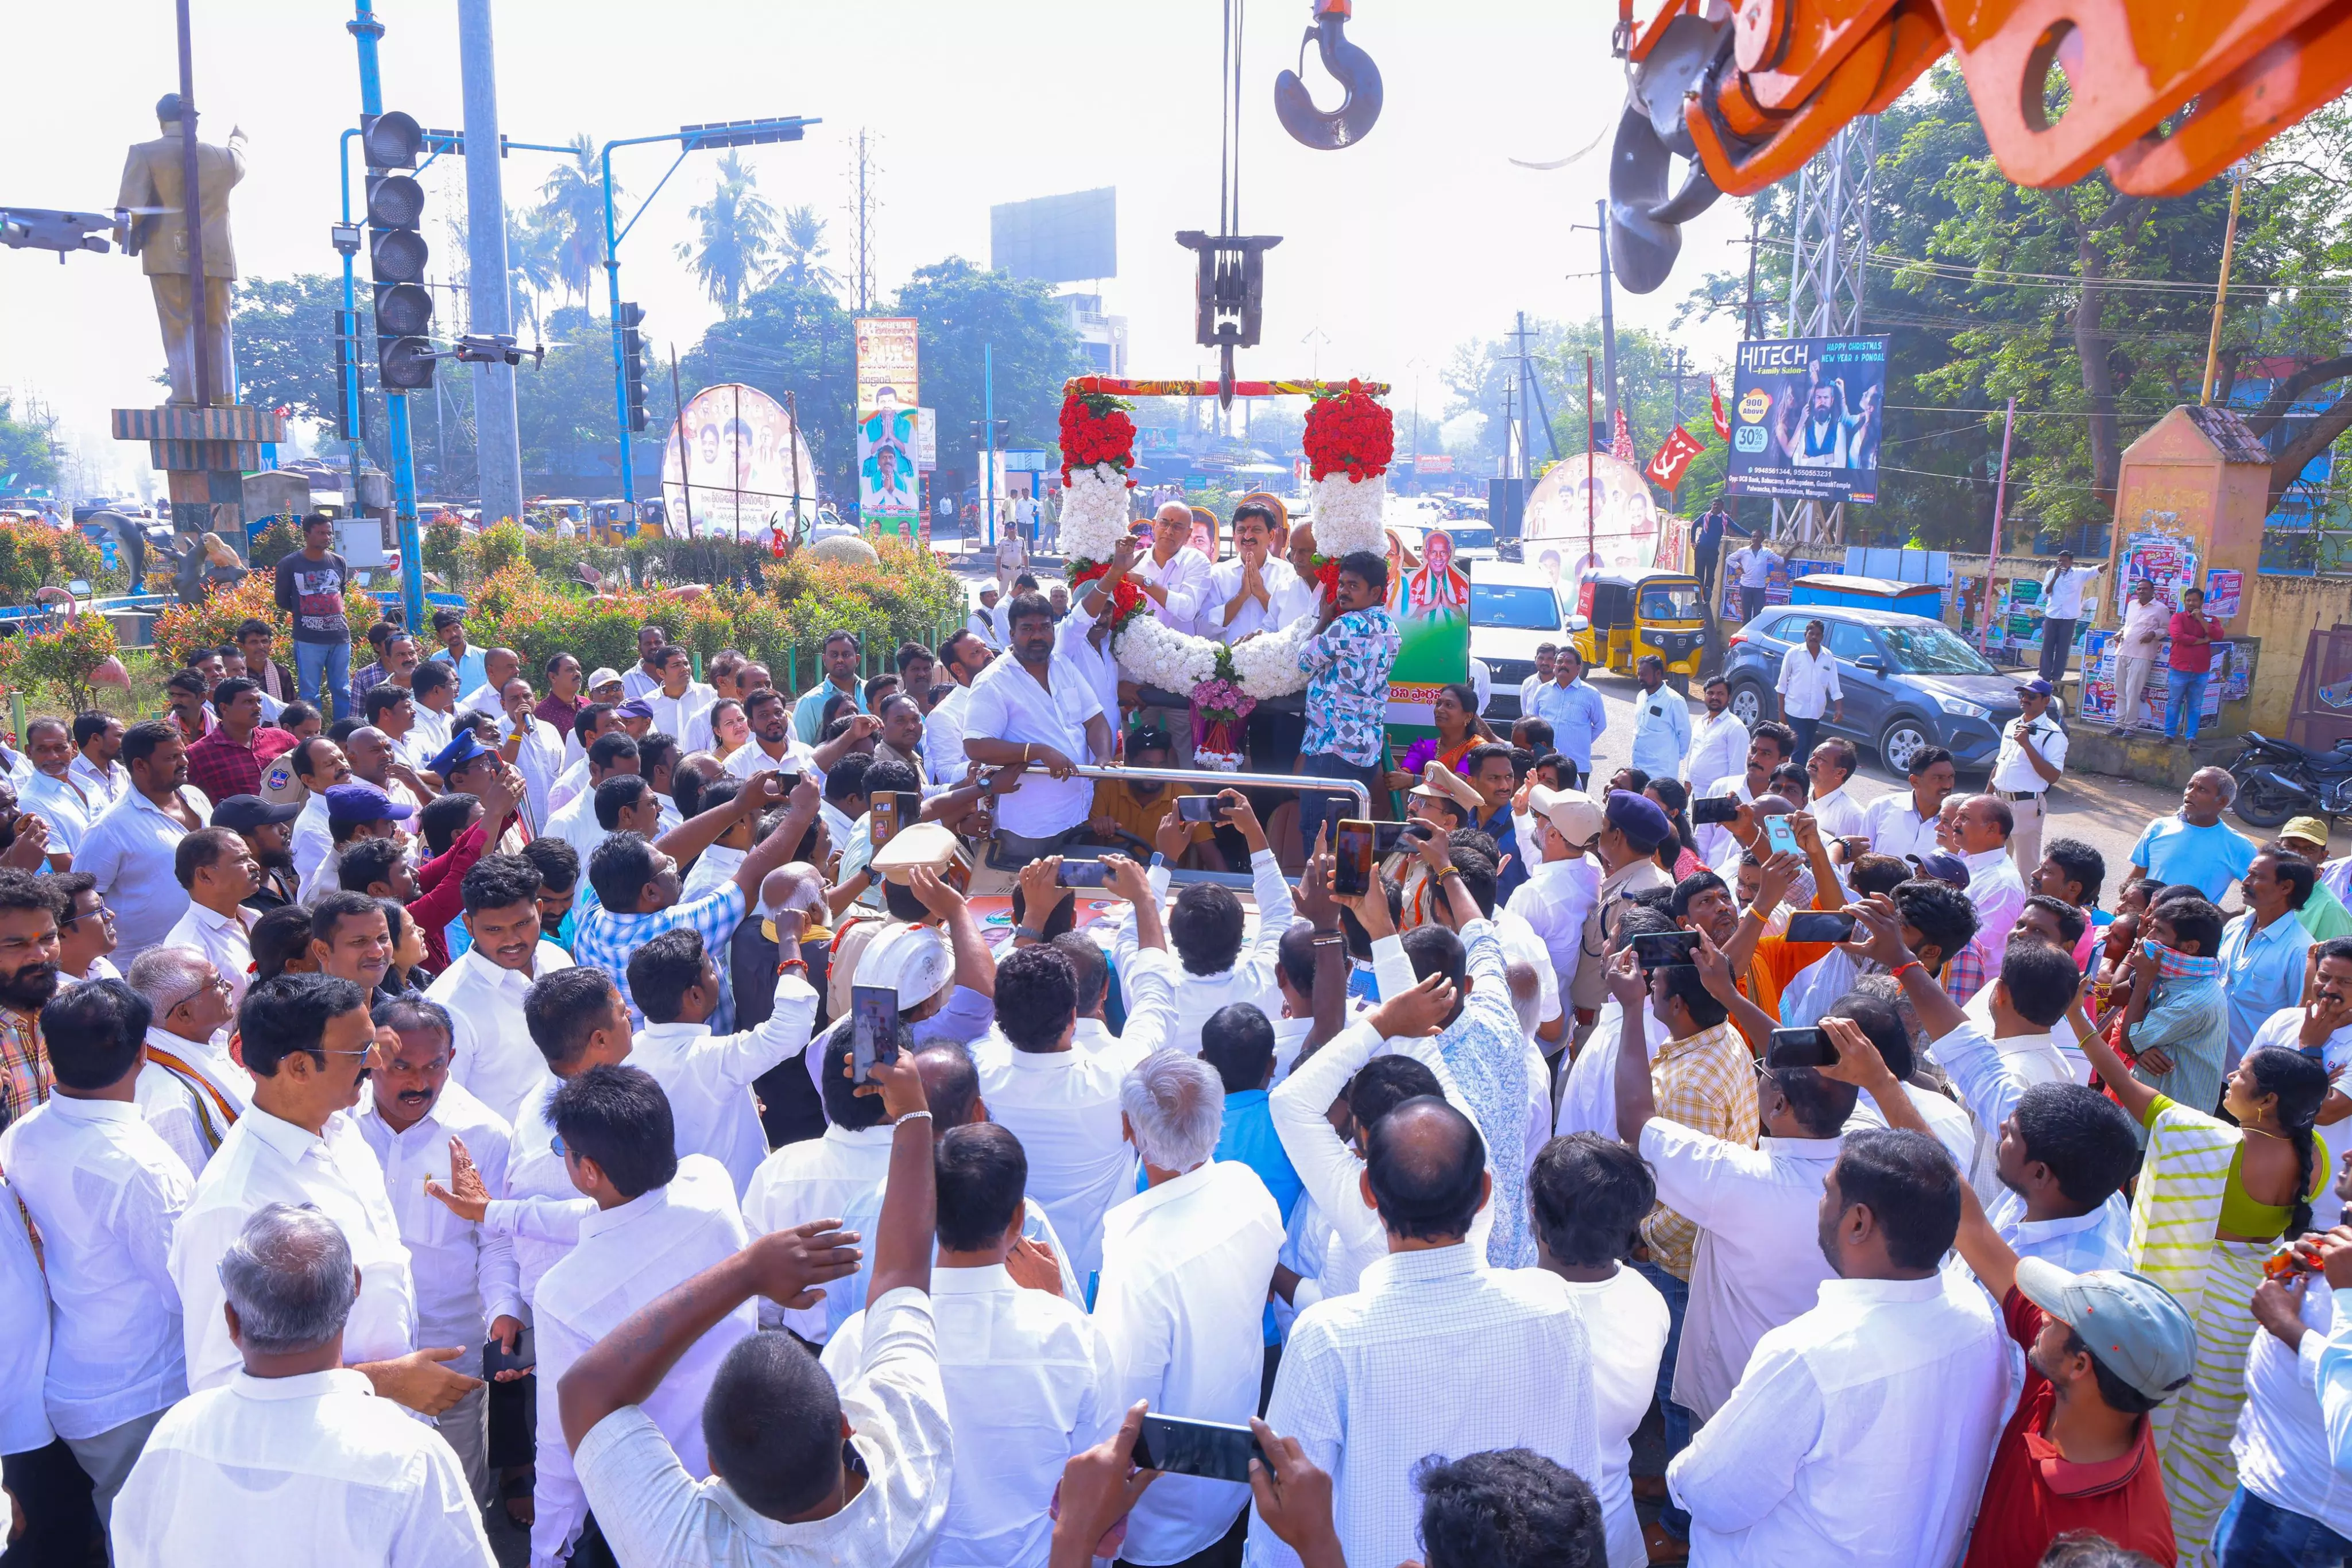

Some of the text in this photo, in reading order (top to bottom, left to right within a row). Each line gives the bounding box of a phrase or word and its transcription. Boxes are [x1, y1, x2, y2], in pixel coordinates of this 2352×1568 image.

[1827, 342, 1882, 351] HAPPY CHRISTMAS
[1740, 344, 1809, 374] HITECH
[1821, 354, 1835, 363] NEW
[1837, 353, 1852, 362] YEAR
[1860, 353, 1885, 362] PONGAL
[1758, 366, 1801, 375] Family Salon
[1739, 428, 1763, 445] 30%
